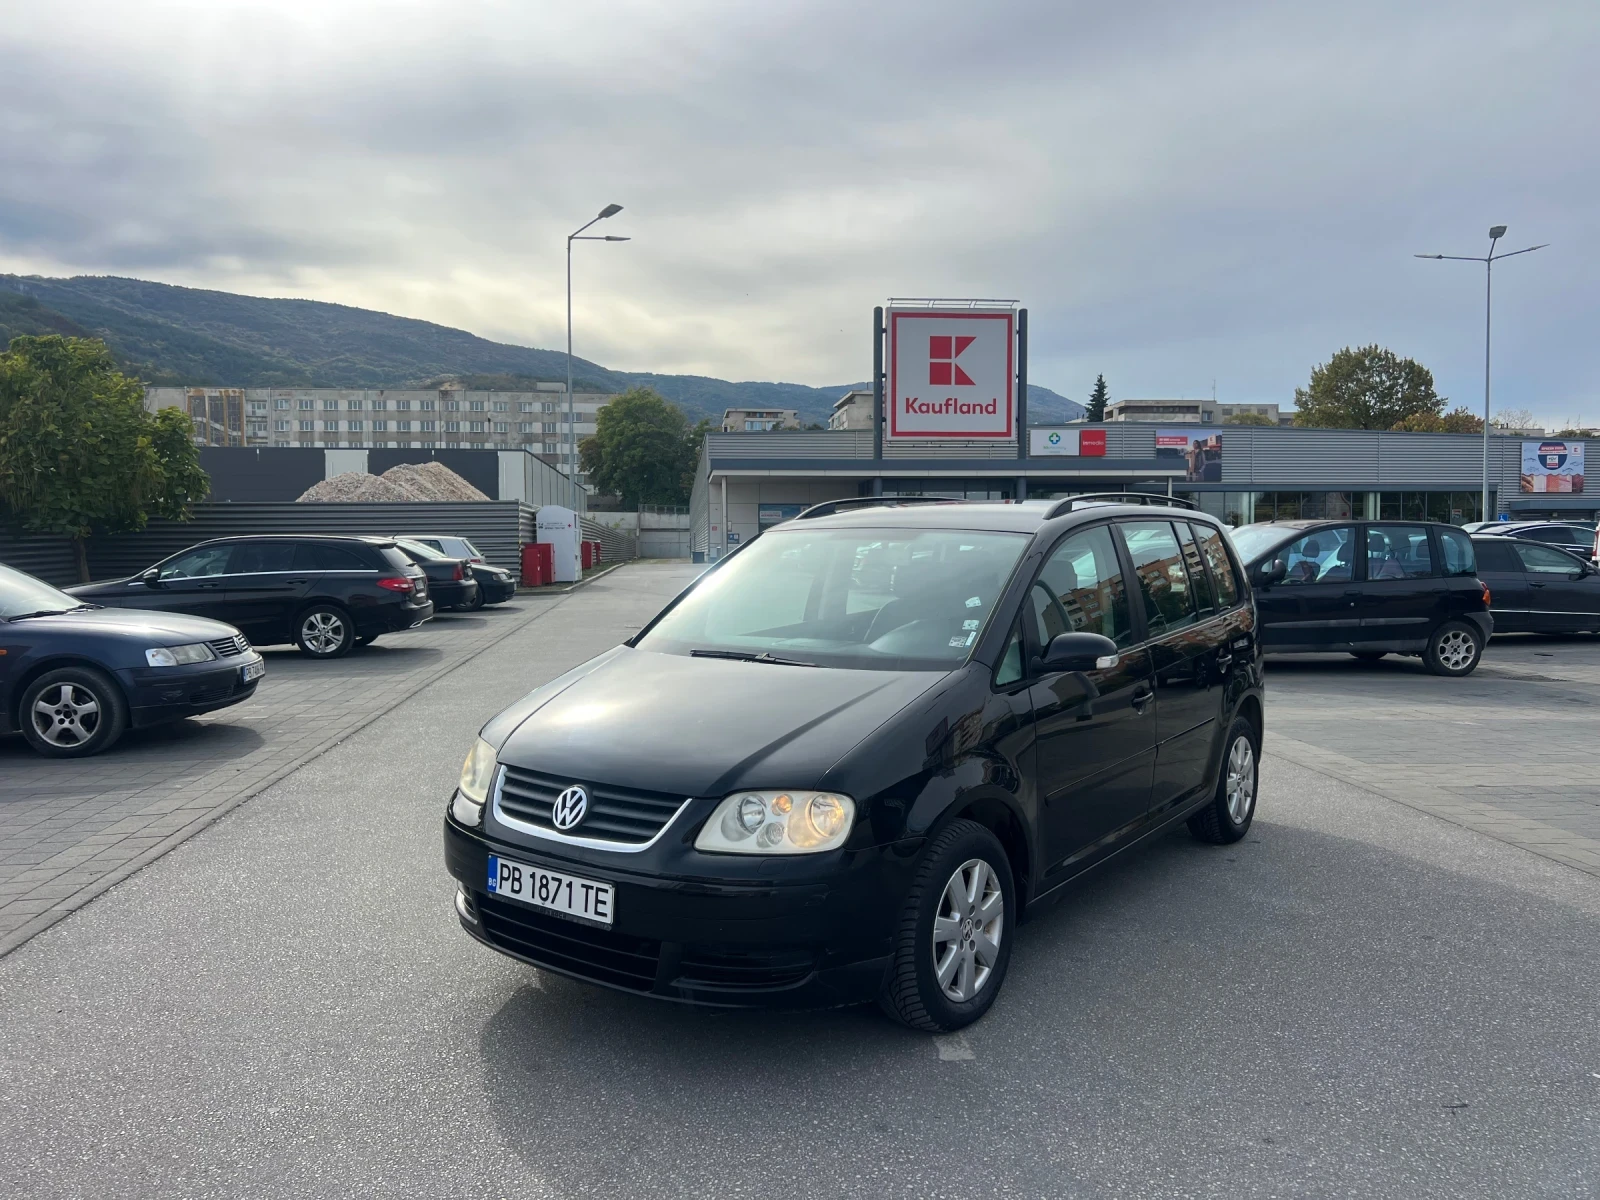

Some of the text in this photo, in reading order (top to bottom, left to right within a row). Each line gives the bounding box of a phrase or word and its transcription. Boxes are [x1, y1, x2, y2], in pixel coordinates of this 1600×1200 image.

[930, 336, 977, 386] K
[905, 397, 997, 415] Kaufland
[488, 877, 497, 887] BG
[499, 862, 523, 895] PB
[529, 871, 573, 909] 1871
[580, 883, 609, 918] TE
